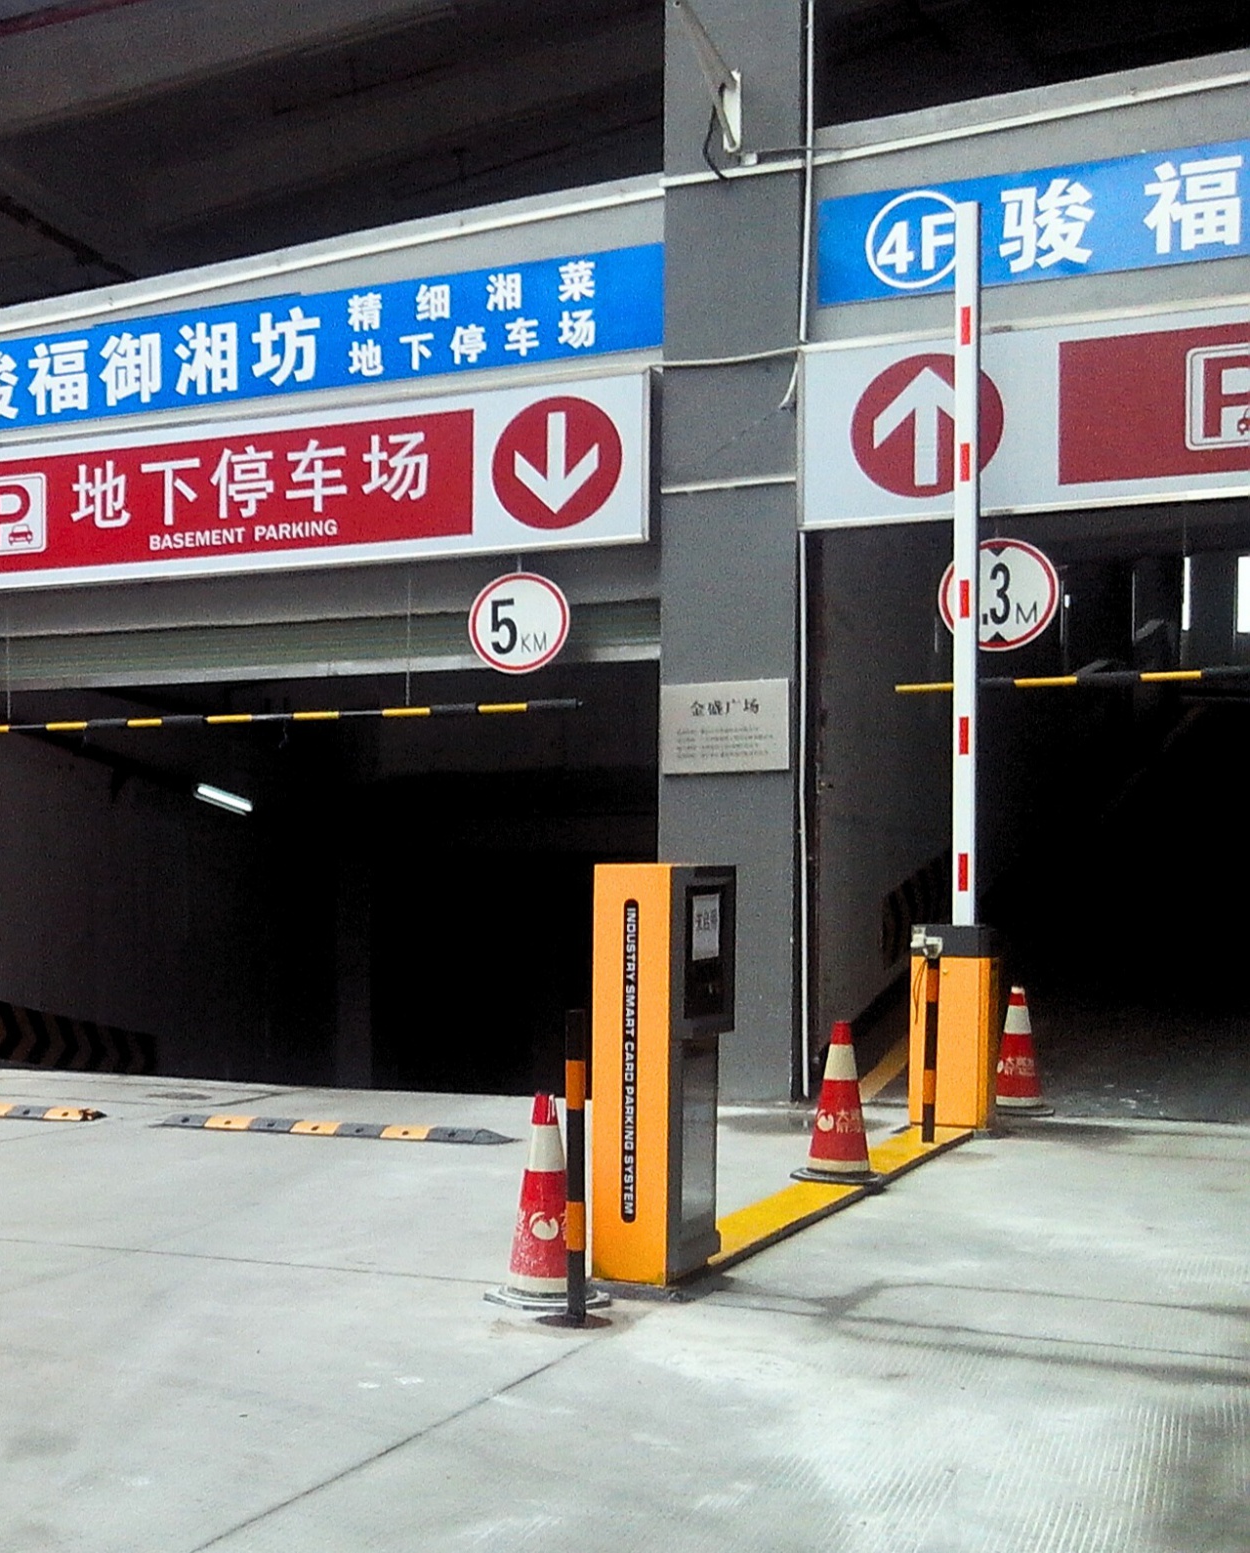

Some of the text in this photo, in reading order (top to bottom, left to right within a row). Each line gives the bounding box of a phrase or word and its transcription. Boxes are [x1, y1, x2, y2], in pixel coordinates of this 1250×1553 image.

[876, 212, 956, 274] 4F
[347, 260, 596, 333] 精细湘菜
[347, 309, 597, 377] 地下停车场
[71, 430, 429, 530] 地下停车场
[149, 518, 338, 552] BASEMENT PARKING
[981, 562, 1038, 625] .3M
[623, 907, 636, 1215] INDUSTRY SMART CARD PARKING SYSTEM
